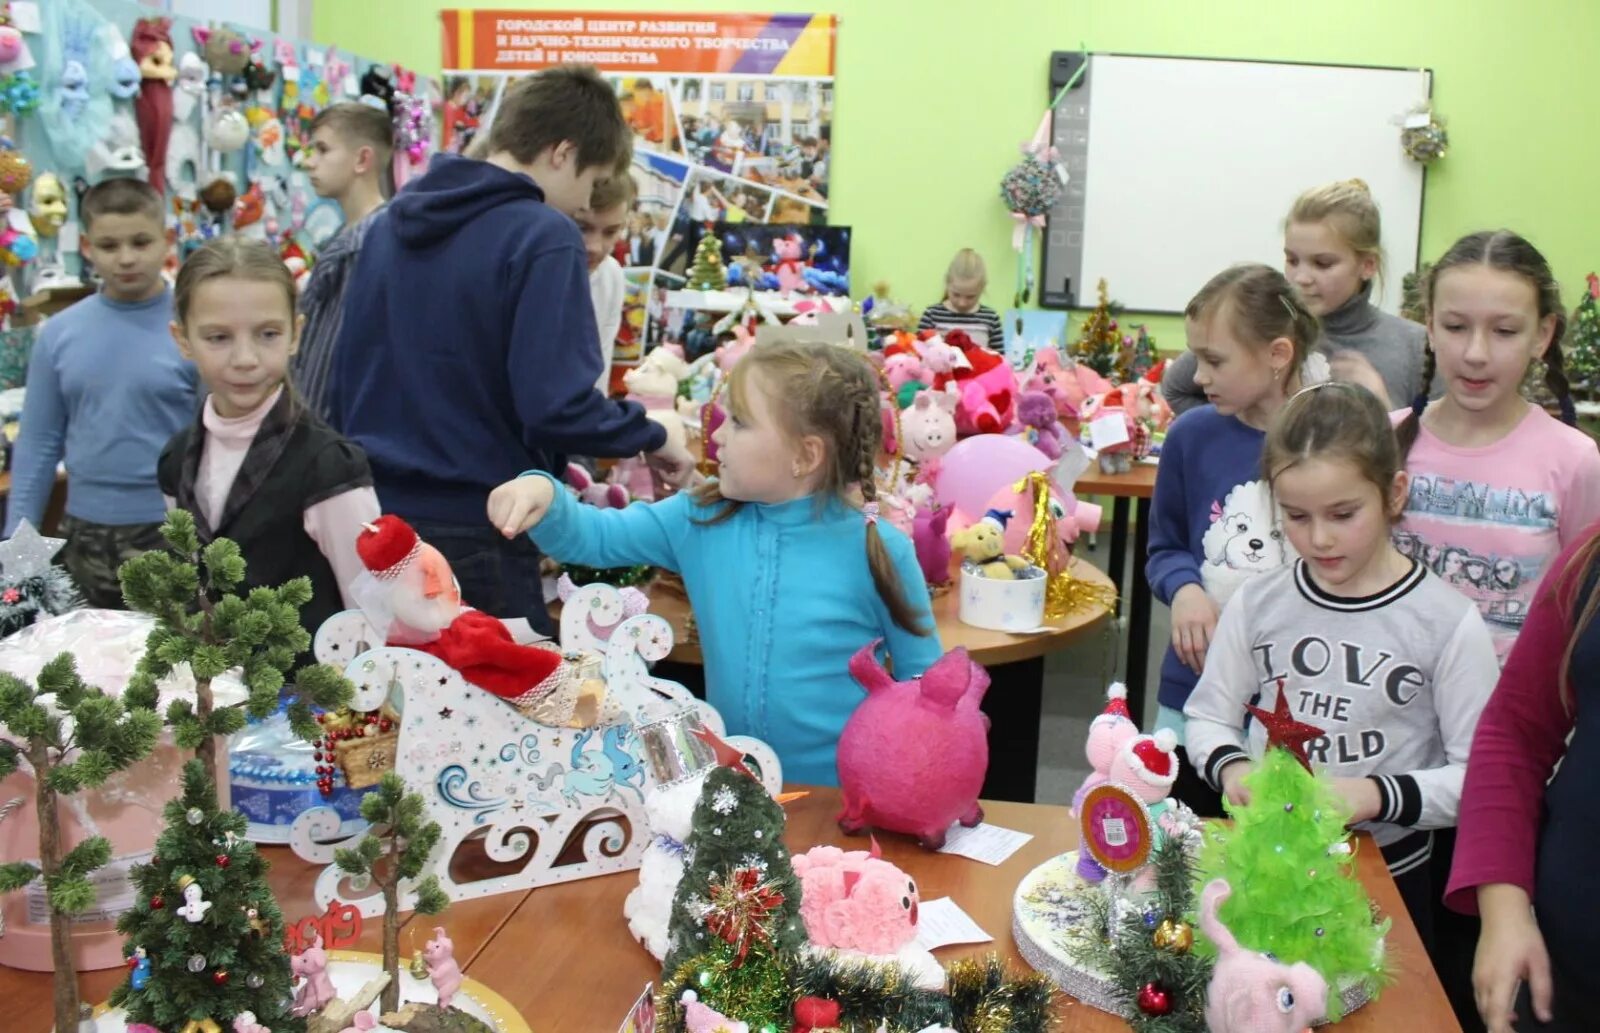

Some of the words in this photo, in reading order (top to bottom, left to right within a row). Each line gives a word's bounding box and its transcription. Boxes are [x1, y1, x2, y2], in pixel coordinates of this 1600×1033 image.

[496, 17, 584, 32] ГОРОДСКОЙ
[587, 20, 637, 33] ЦЕНТР
[639, 21, 717, 34] РАЗВИТИЯ
[496, 34, 508, 47] И
[510, 34, 691, 49] НАУЧНО-ТЕХНИЧЕСКОГО
[693, 37, 789, 50] ТВОРЧЕСТВА
[495, 48, 544, 64] ДЕТЕЙ
[547, 50, 559, 63] И
[561, 51, 659, 64] ЮНОШЕСТВА
[1299, 690, 1352, 722] THE
[1306, 730, 1385, 764] RLD
